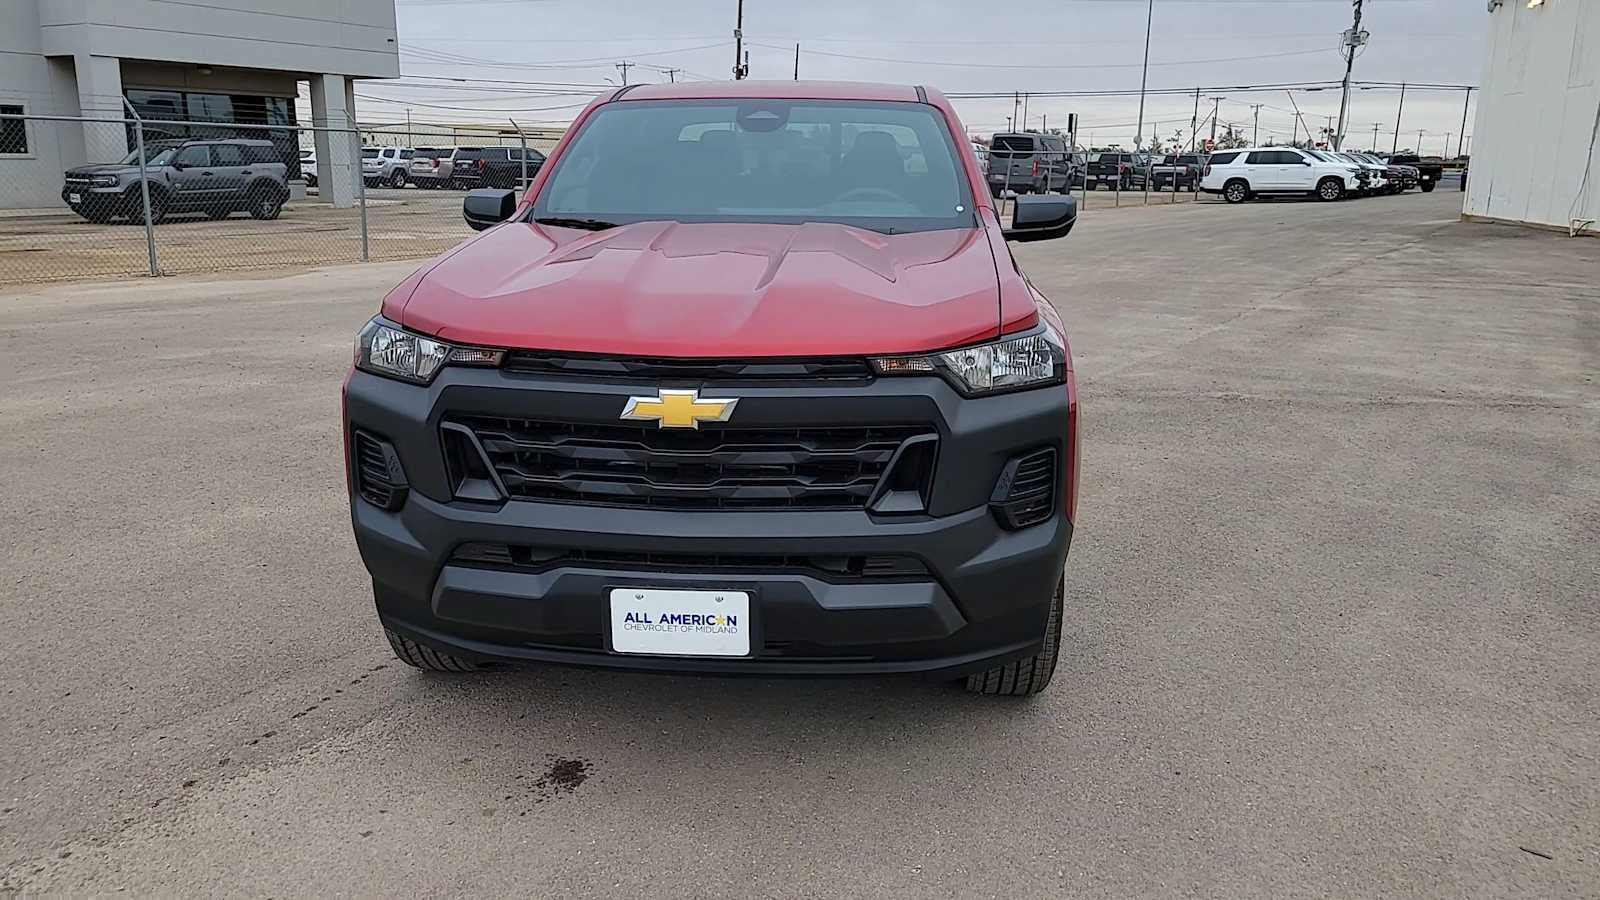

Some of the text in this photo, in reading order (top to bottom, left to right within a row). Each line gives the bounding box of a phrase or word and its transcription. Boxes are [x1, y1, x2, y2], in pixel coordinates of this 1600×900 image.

[624, 612, 652, 624] ALL
[624, 623, 738, 634] CHEVROLET OF MIDLAND
